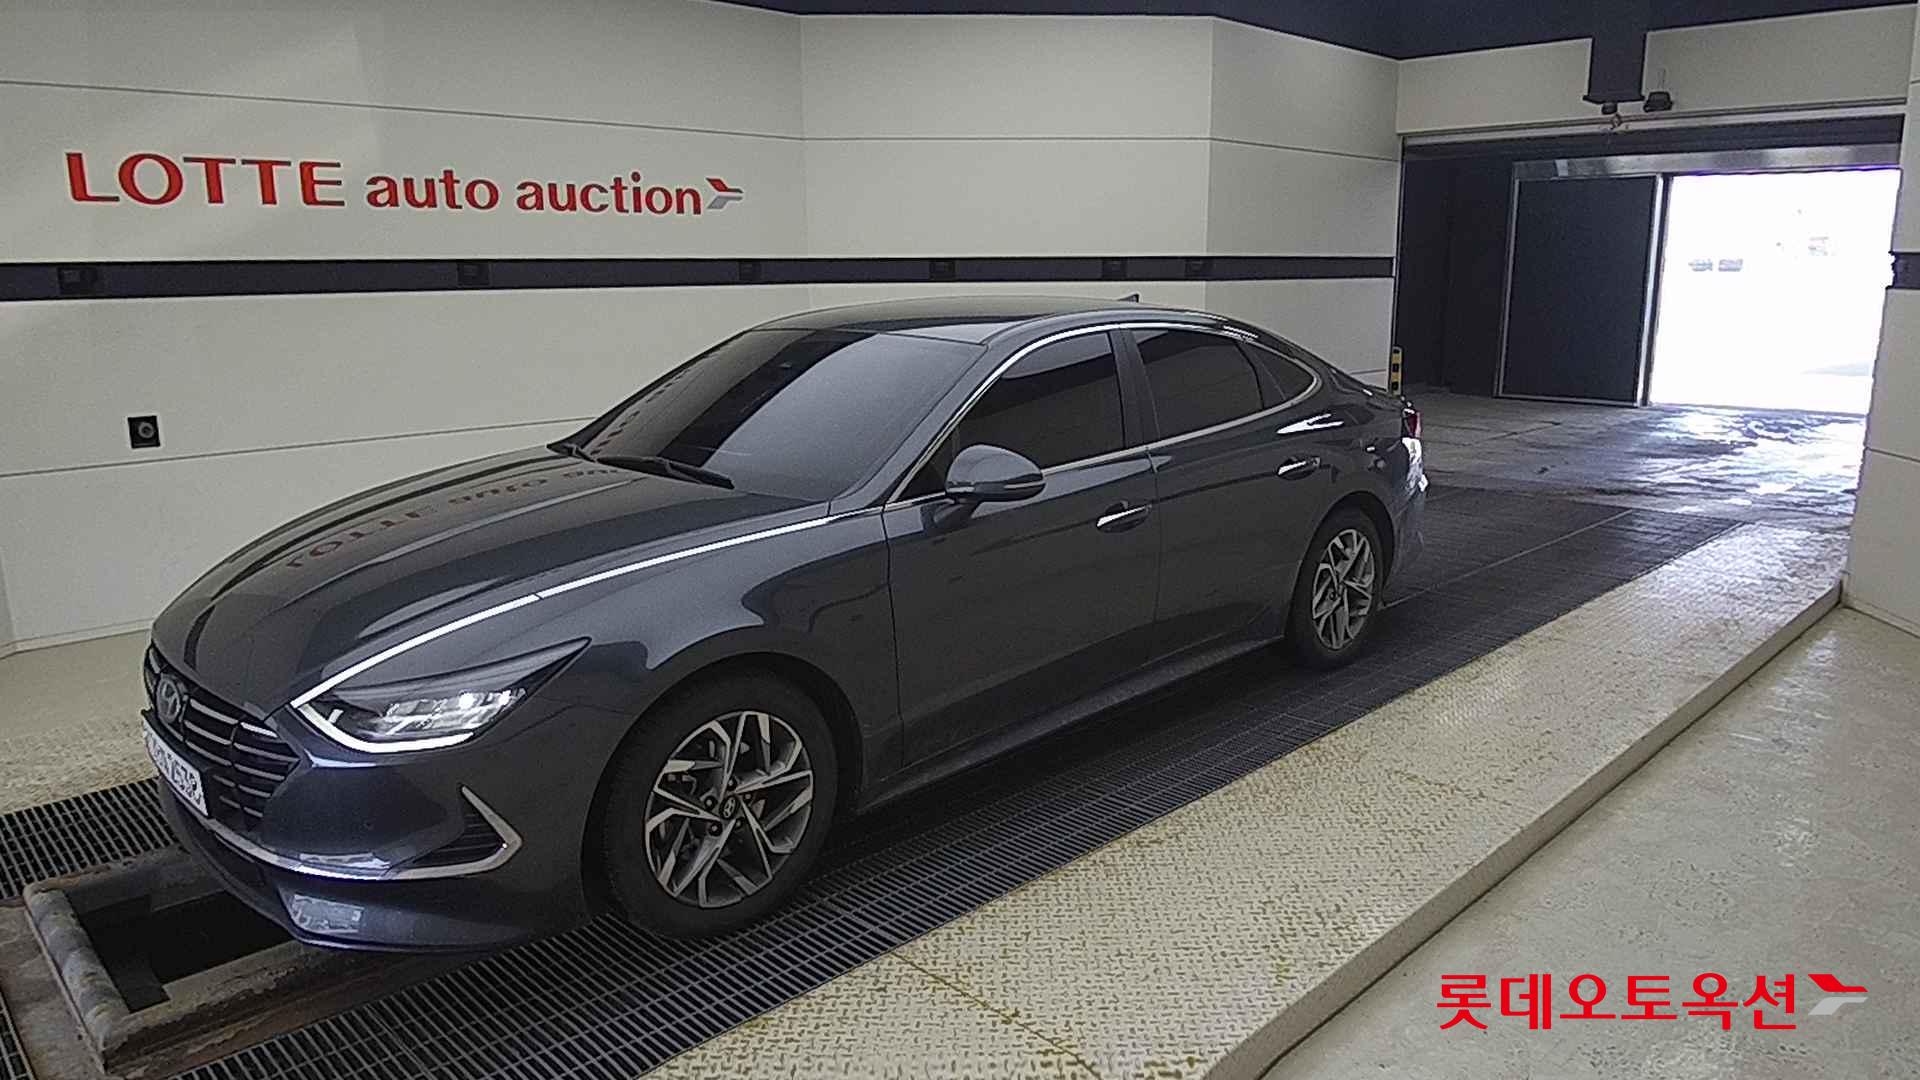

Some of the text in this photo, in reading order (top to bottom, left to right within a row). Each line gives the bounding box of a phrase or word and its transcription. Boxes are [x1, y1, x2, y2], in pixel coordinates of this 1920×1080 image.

[66, 152, 702, 215] LOTTE auto auction
